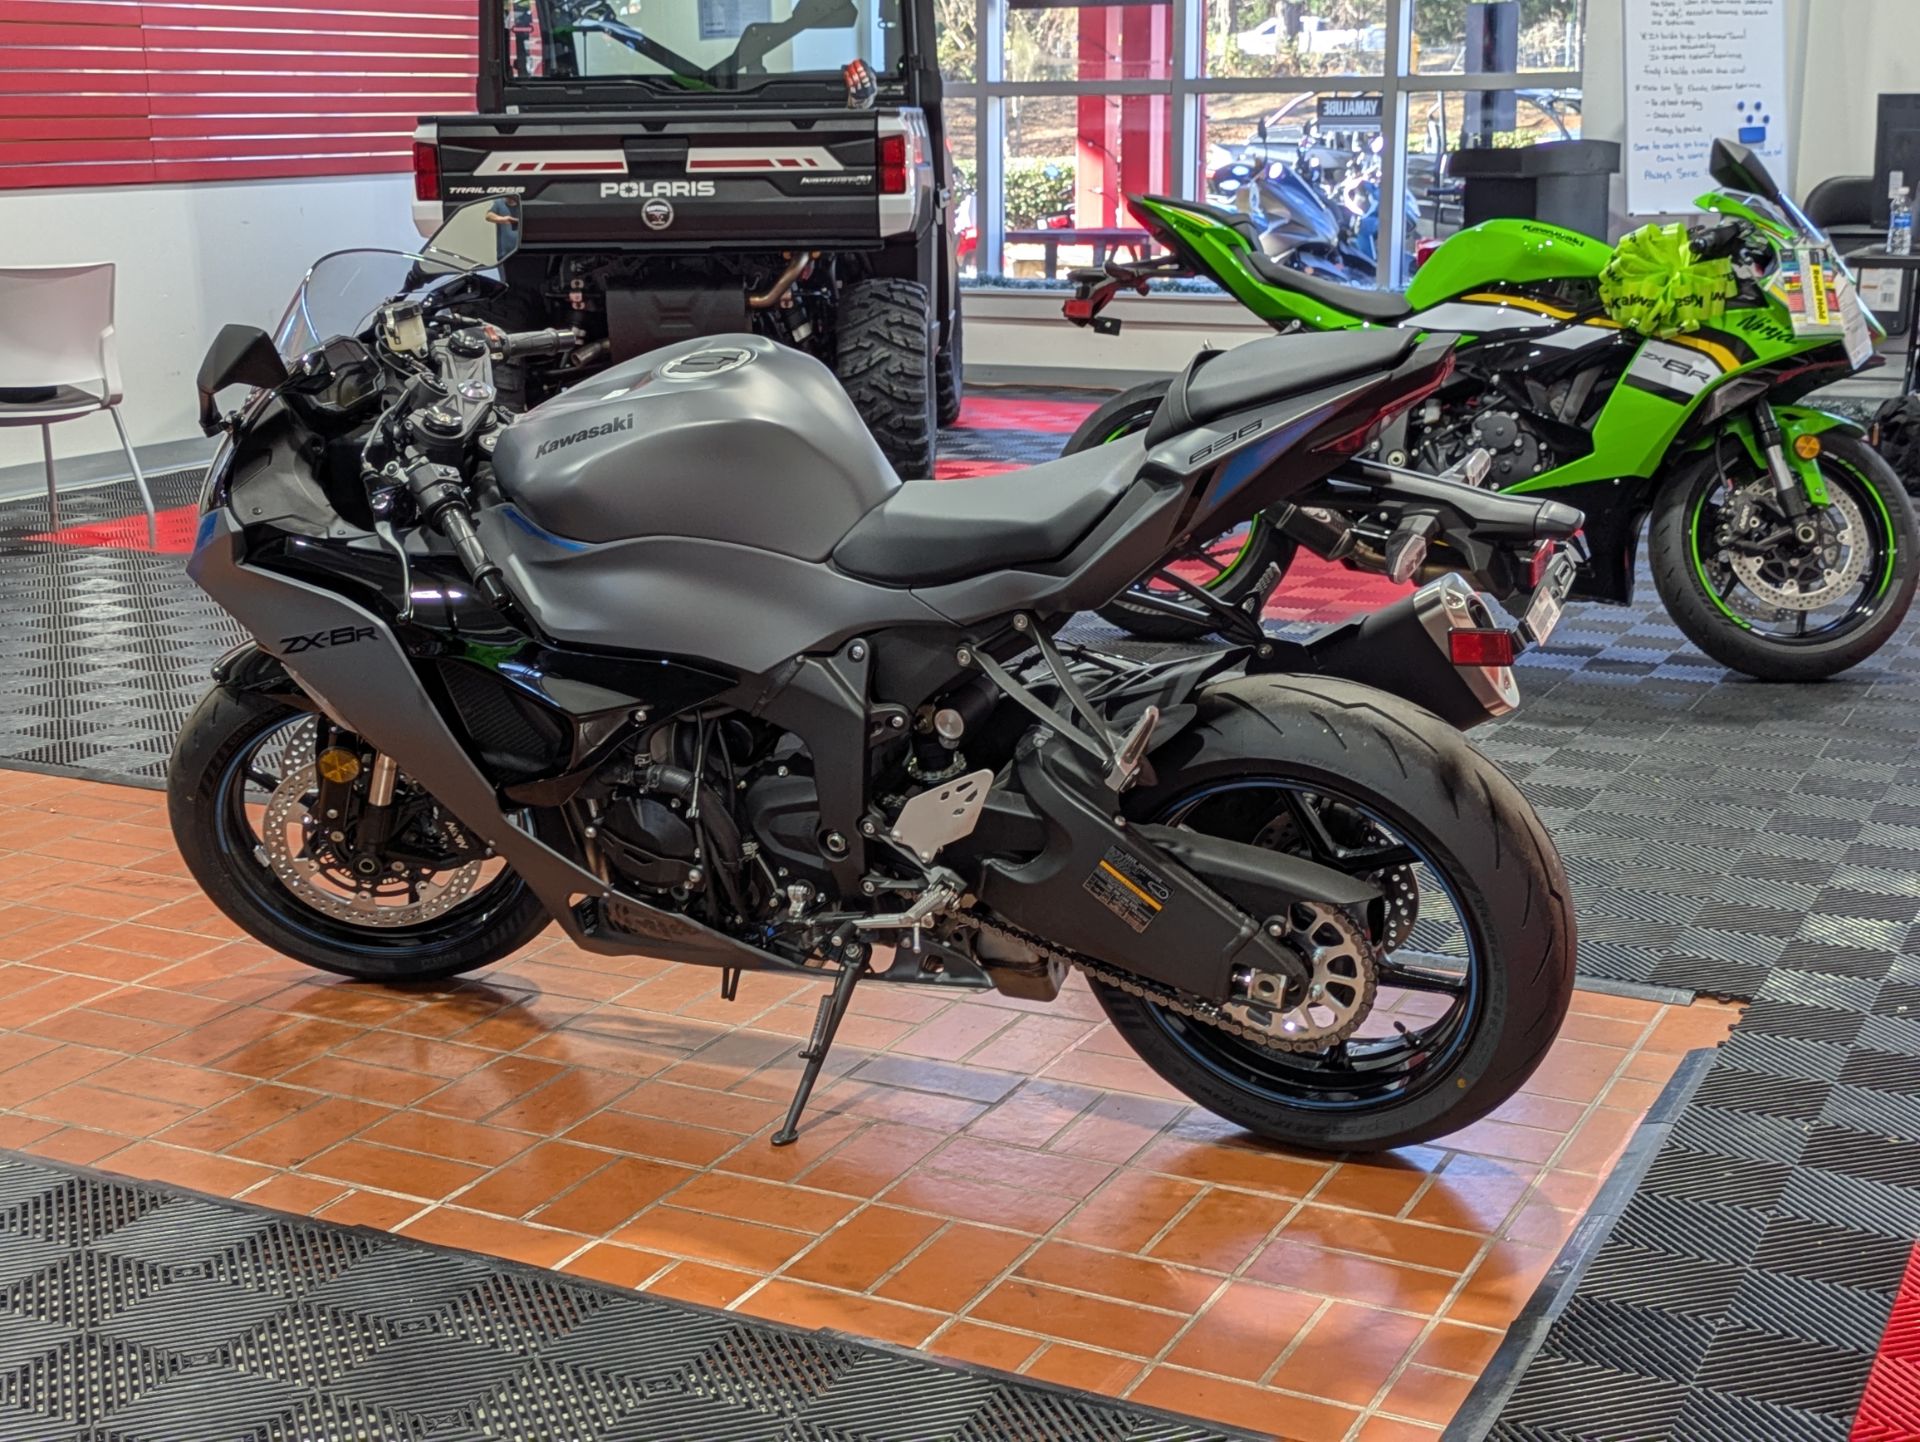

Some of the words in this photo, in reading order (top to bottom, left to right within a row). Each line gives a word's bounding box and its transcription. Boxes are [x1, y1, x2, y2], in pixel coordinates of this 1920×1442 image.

[449, 186, 485, 194] TRAIL
[600, 181, 716, 199] POLARIS
[1736, 314, 1797, 344] Ninja
[535, 413, 633, 459] Kawasaki
[1188, 418, 1263, 466] 636
[280, 626, 379, 655] ZX-6R
